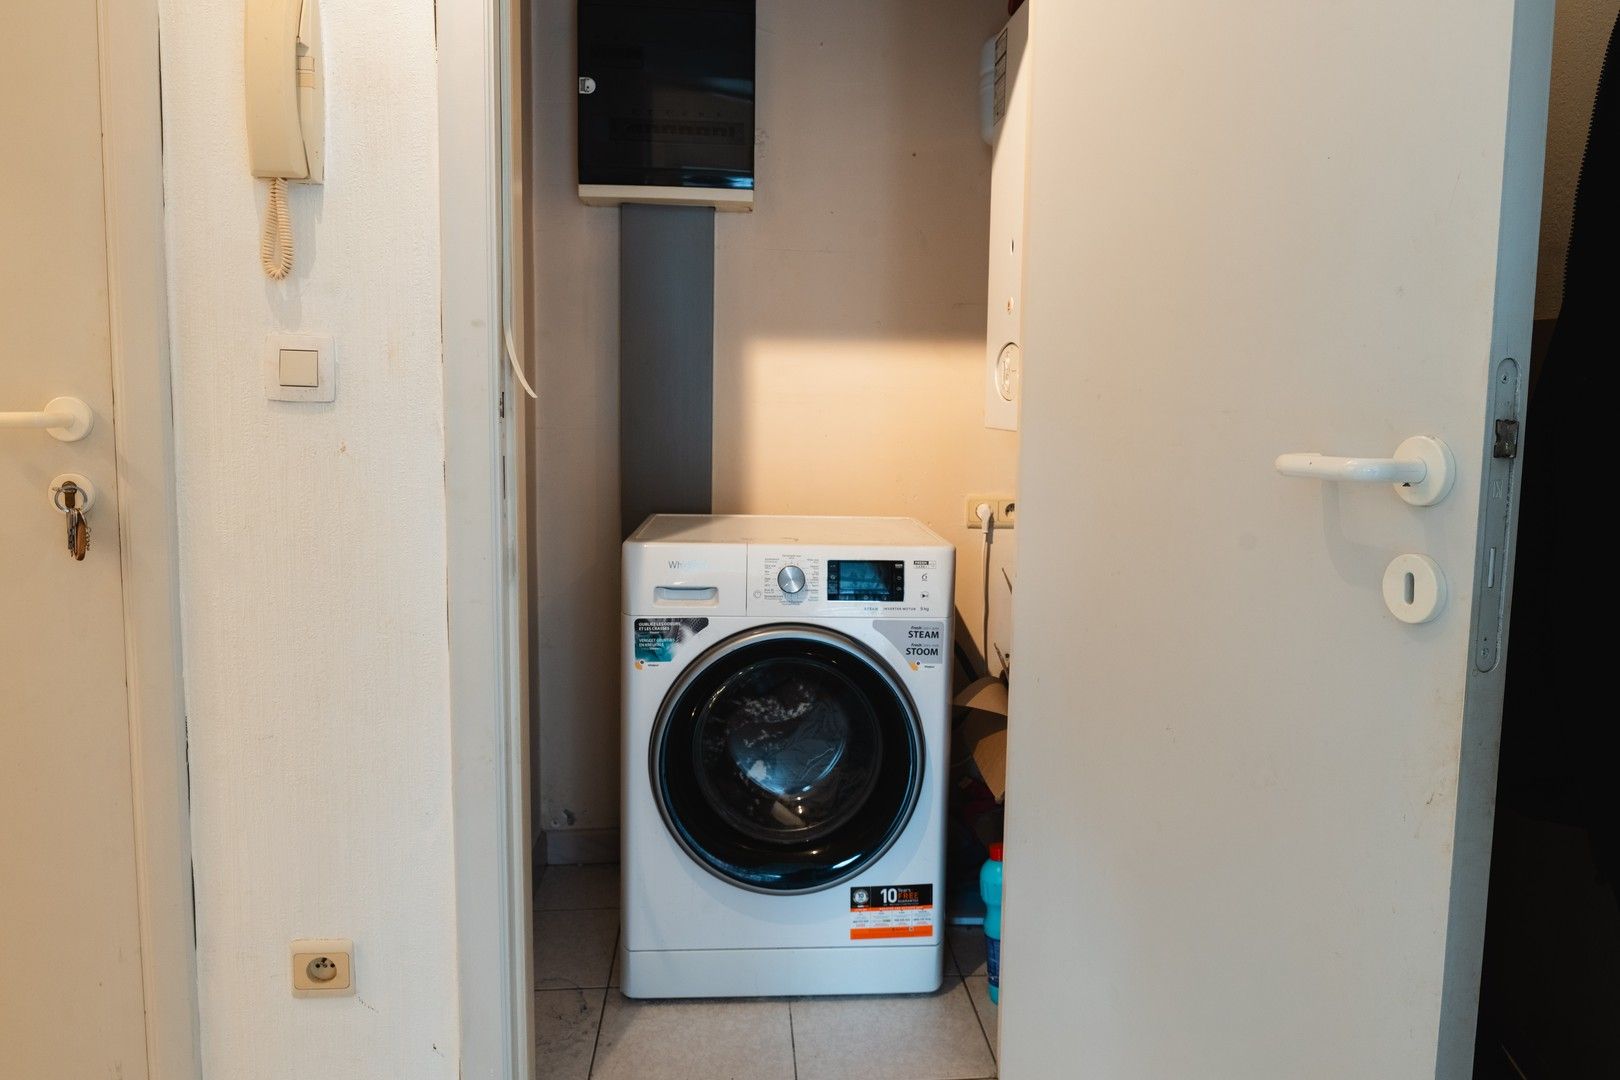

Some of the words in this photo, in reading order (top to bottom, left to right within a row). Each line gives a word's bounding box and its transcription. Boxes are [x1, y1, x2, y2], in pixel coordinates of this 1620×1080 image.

[908, 630, 939, 639] STEAM
[905, 648, 939, 656] STOOM
[880, 887, 898, 903] 10
